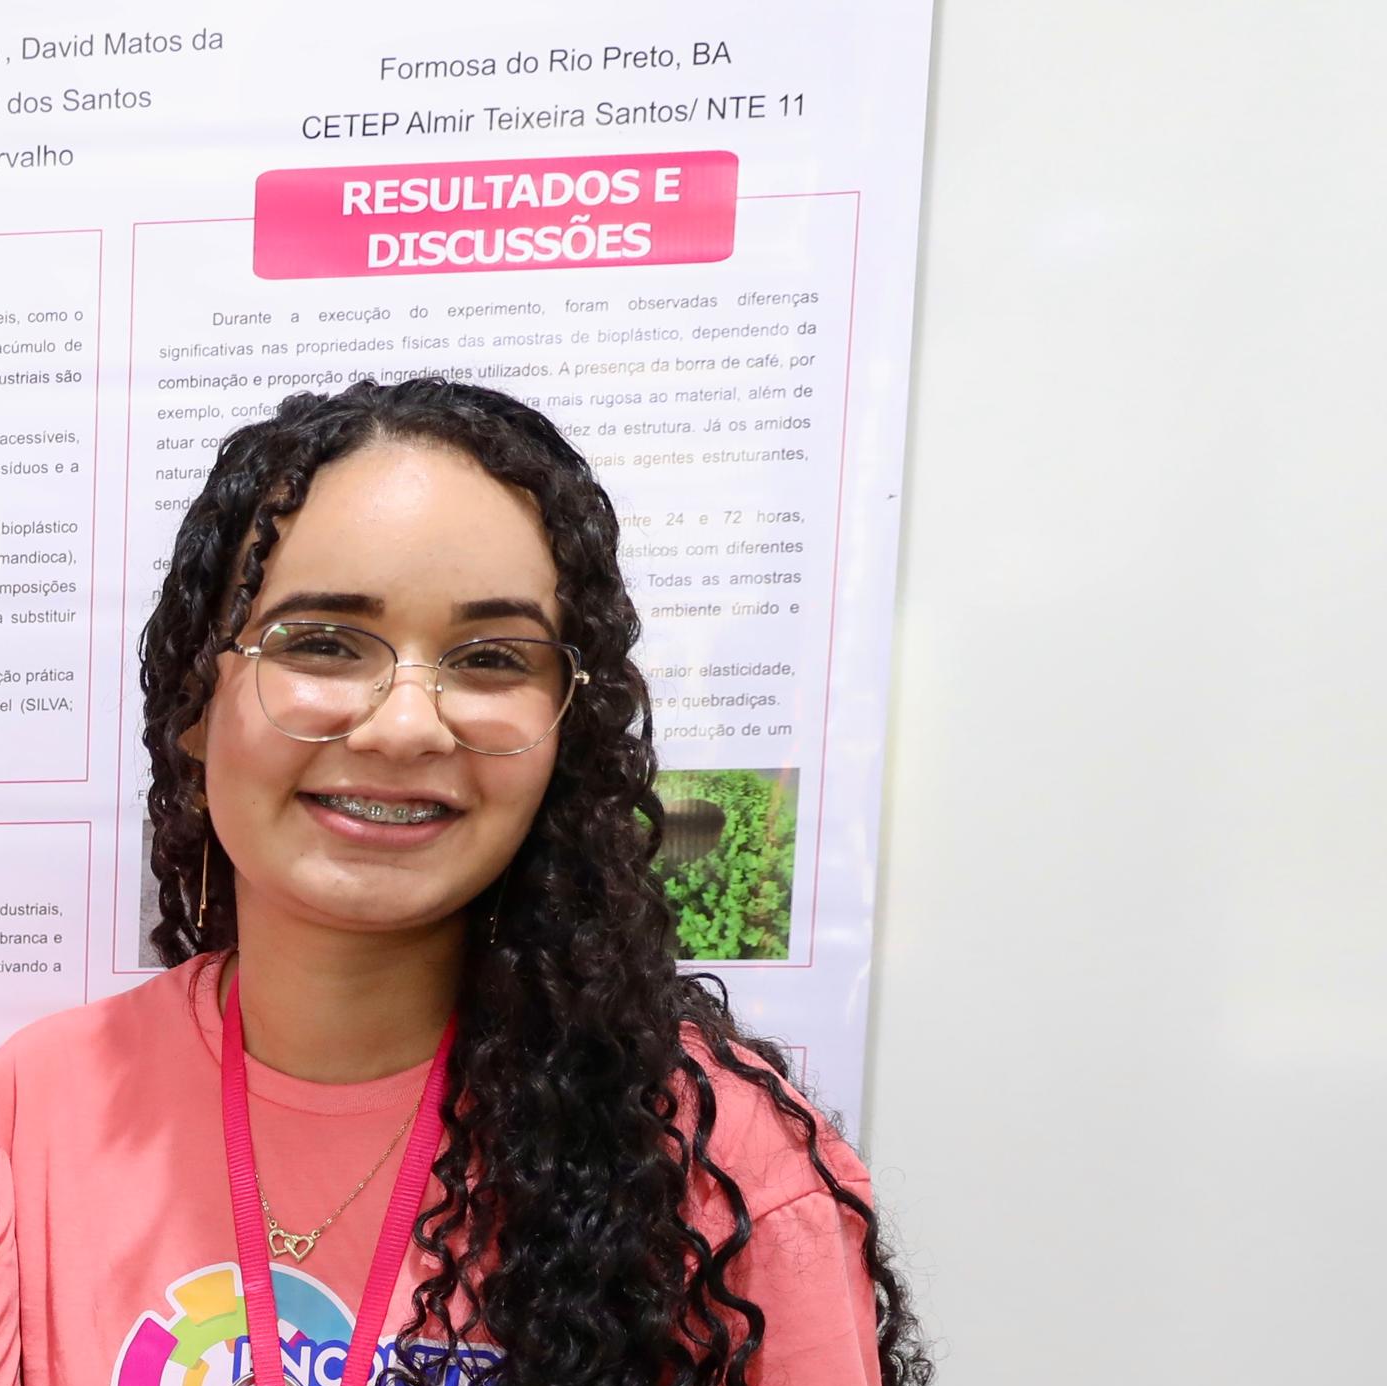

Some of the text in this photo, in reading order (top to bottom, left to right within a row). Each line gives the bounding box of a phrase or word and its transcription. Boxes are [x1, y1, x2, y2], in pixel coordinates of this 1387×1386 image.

[22, 34, 93, 59] David
[105, 32, 182, 55] Matos
[192, 28, 222, 50] da
[381, 41, 731, 80] Formosa do Rio Preto, BA
[8, 92, 52, 114] dos
[63, 88, 151, 111] Santos
[302, 94, 803, 139] CETEP Almir Teixeira Santos/ NTE 11
[343, 169, 681, 214] RESULTADOS E
[369, 215, 651, 267] DISCUSSÕES
[213, 292, 819, 326] Durante execução experimento, observadas diferenças
[159, 323, 789, 361] significativas propriedades bioplástico, dependendo
[158, 374, 248, 390] combinação
[268, 370, 343, 388] proporção
[478, 363, 552, 379] utilizados.
[158, 387, 740, 421] exemplo, material,
[624, 416, 811, 435] estrutura. amidos
[0, 430, 79, 445] acessíveis,
[703, 448, 808, 463] estruturantes,
[666, 510, 804, 526] 24 72 horas,
[2, 520, 78, 537] bioplástico
[726, 541, 803, 554] diferentes
[730, 571, 802, 585] amostras
[11, 609, 76, 624] substituir
[26, 669, 74, 685] prática
[699, 662, 795, 677] elasticidade,
[21, 697, 72, 714] (SILVA;
[682, 693, 780, 710] quebradiças.
[664, 724, 736, 741] produção
[0, 932, 48, 944] branca
